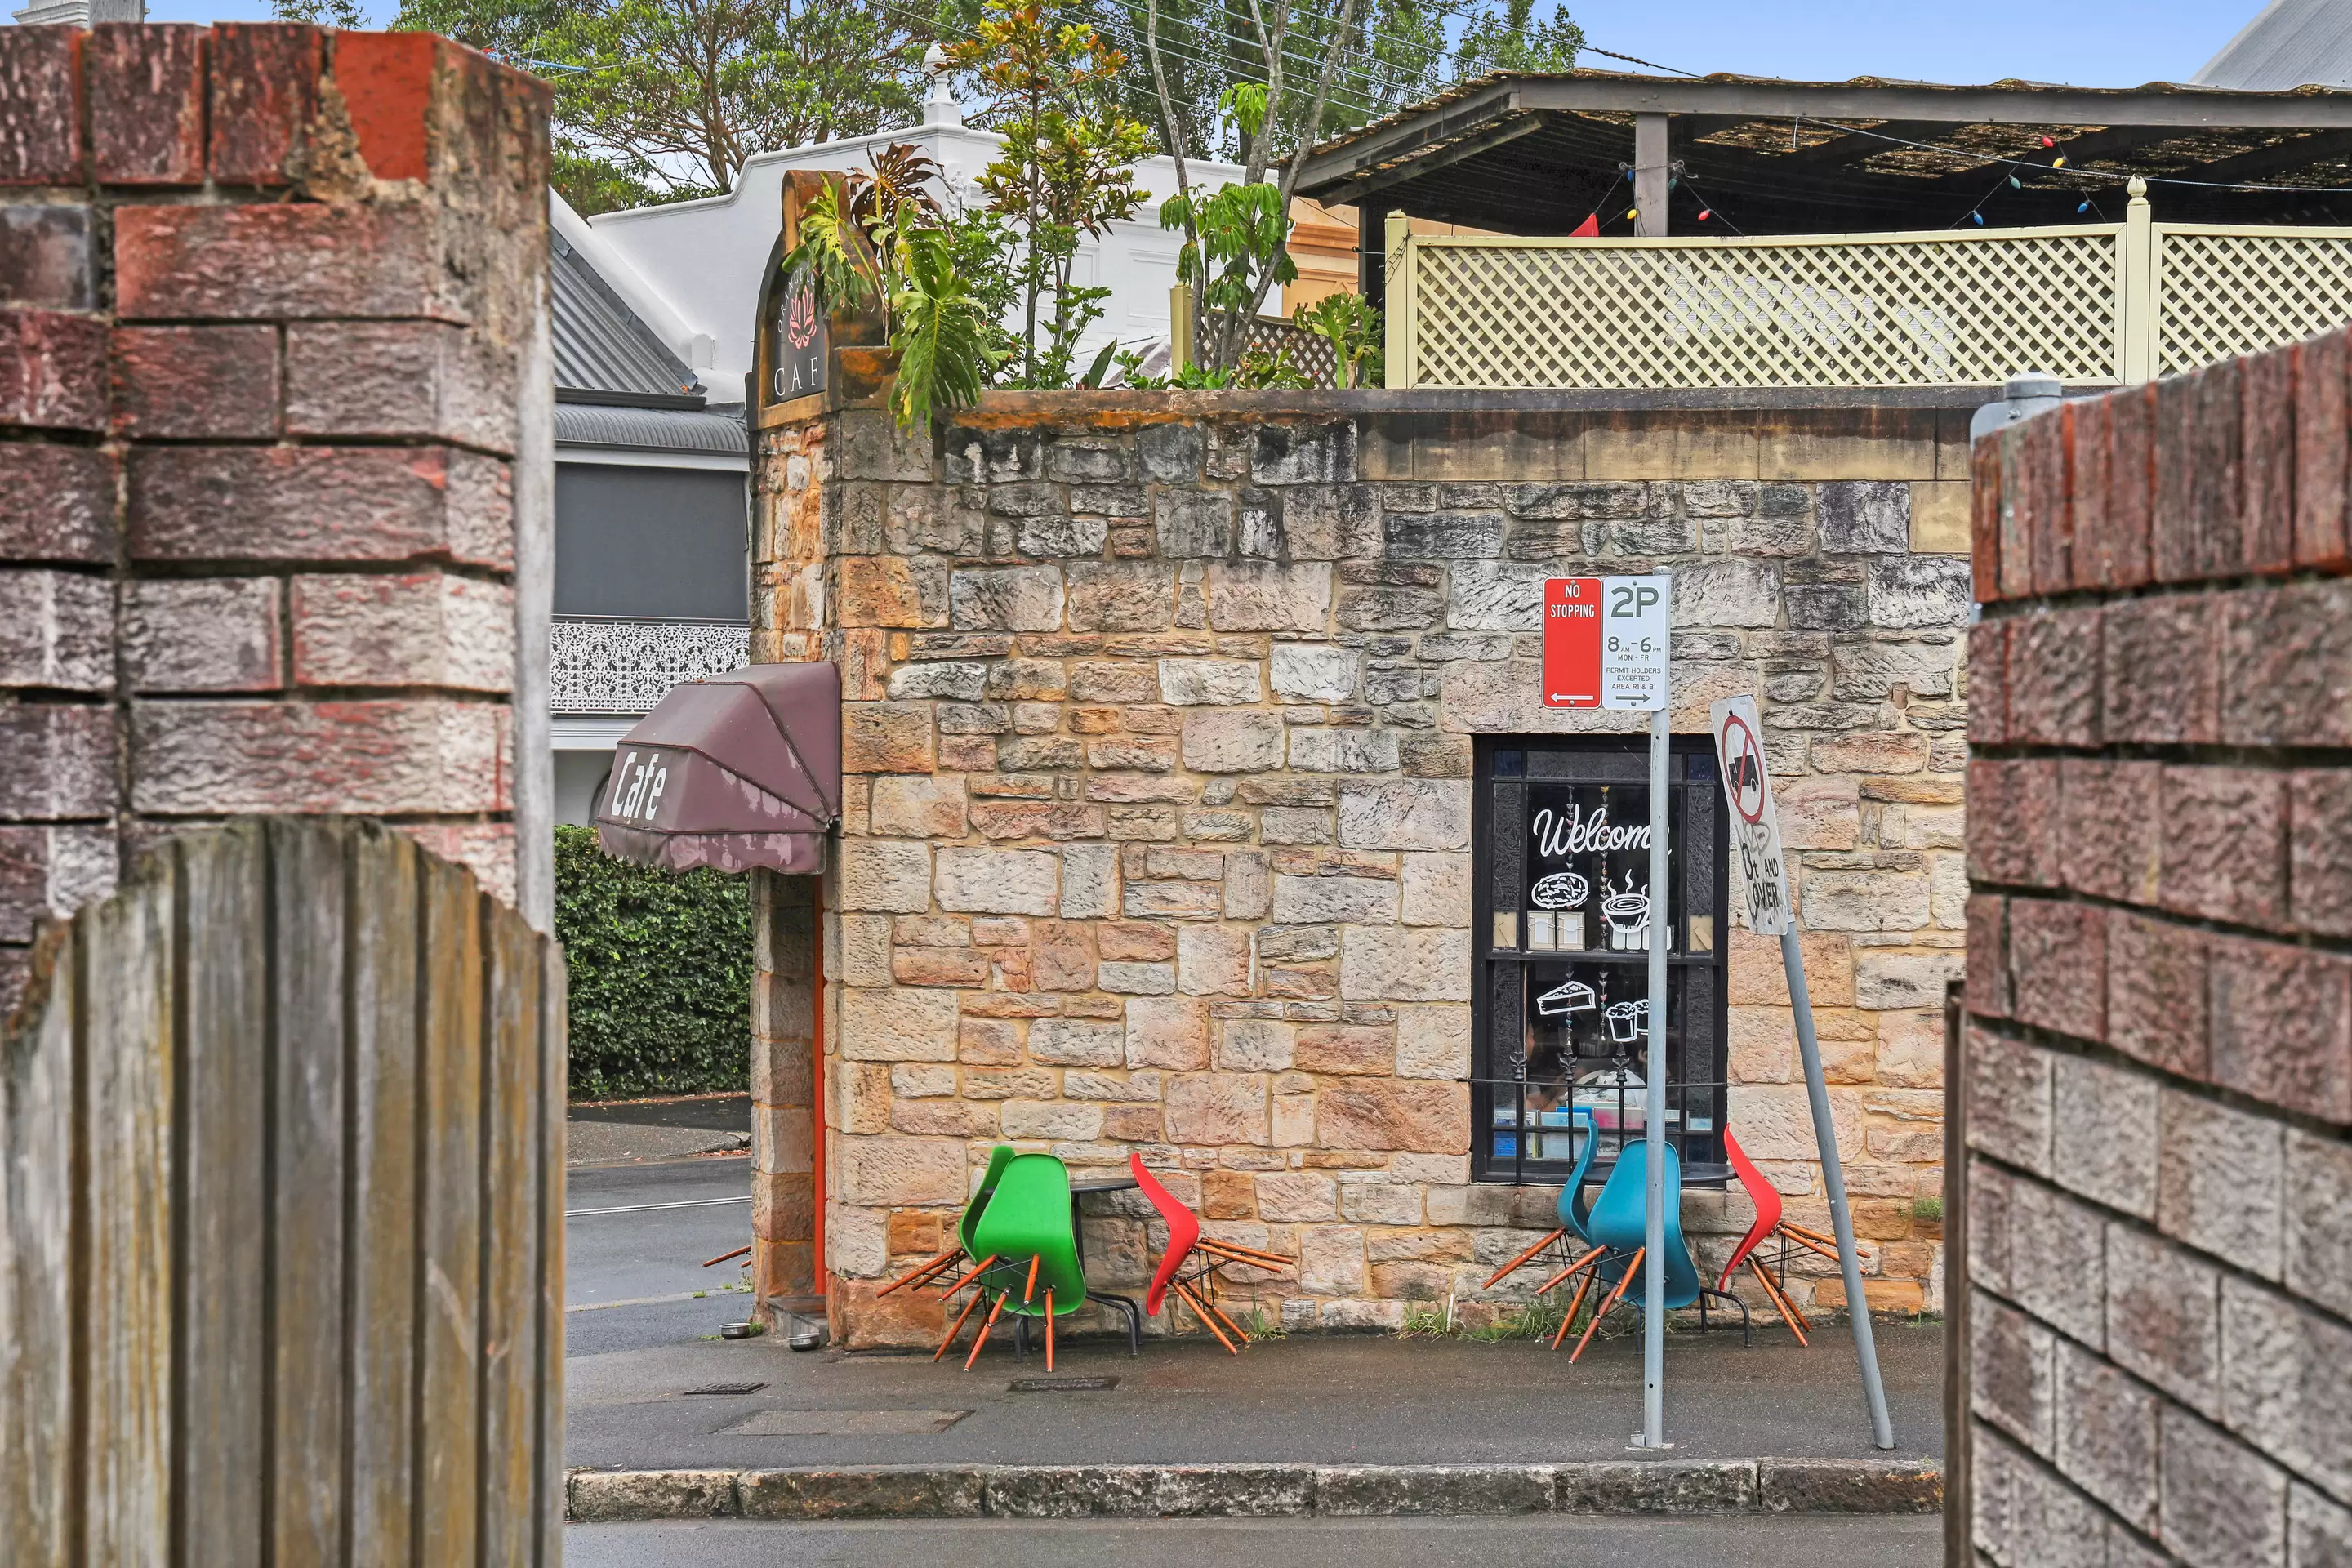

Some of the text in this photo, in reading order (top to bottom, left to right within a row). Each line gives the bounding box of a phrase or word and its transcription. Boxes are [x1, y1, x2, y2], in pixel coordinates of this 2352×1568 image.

[777, 267, 804, 333] ORANGE
[1565, 584, 1581, 598] NO
[1610, 586, 1659, 617] 2P
[1550, 604, 1595, 618] STOPPING
[612, 751, 667, 820] Cafe
[1533, 804, 1672, 858] Welcom
[1764, 858, 1779, 878] AND
[1752, 882, 1780, 908] OVER
